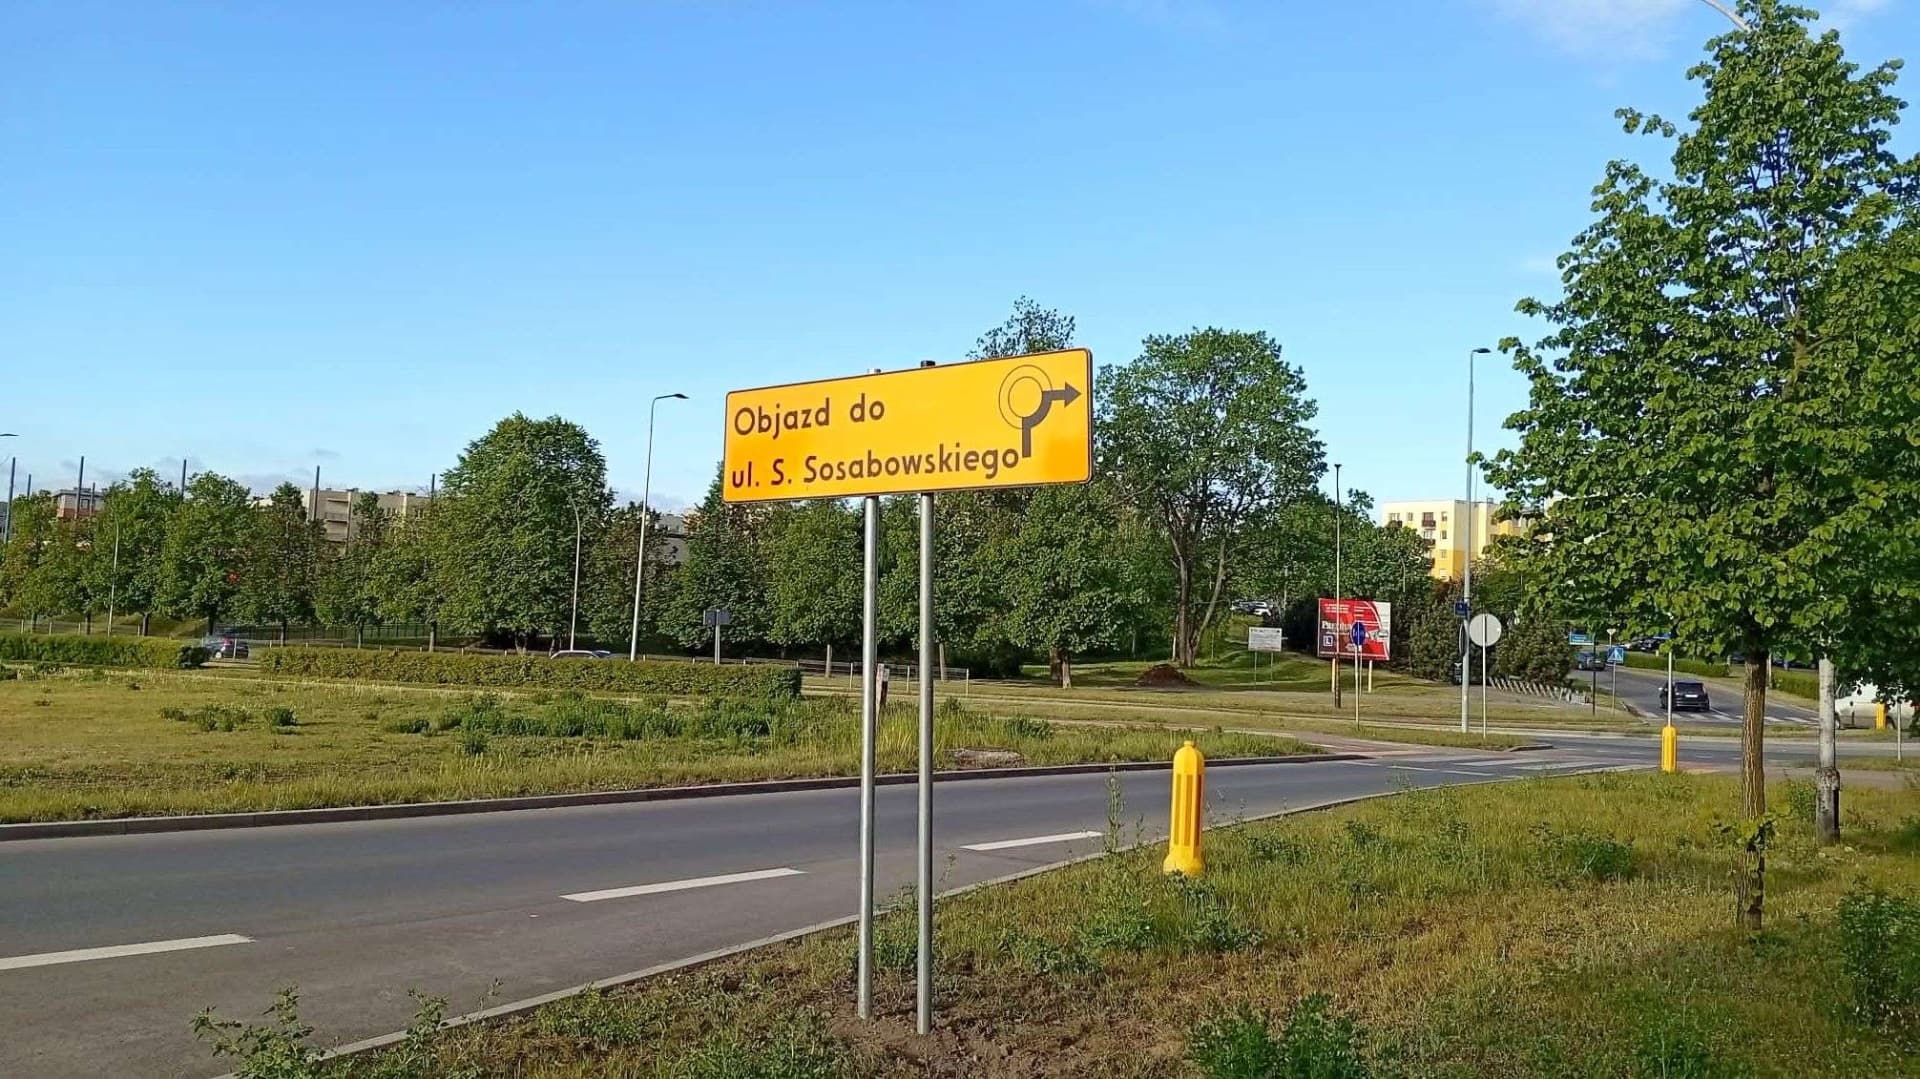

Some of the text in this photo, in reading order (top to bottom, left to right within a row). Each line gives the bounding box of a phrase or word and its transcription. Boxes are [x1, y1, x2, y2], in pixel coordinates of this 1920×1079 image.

[734, 393, 885, 440] Objazd do
[732, 443, 1019, 488] ul. S. Sosabowskiego
